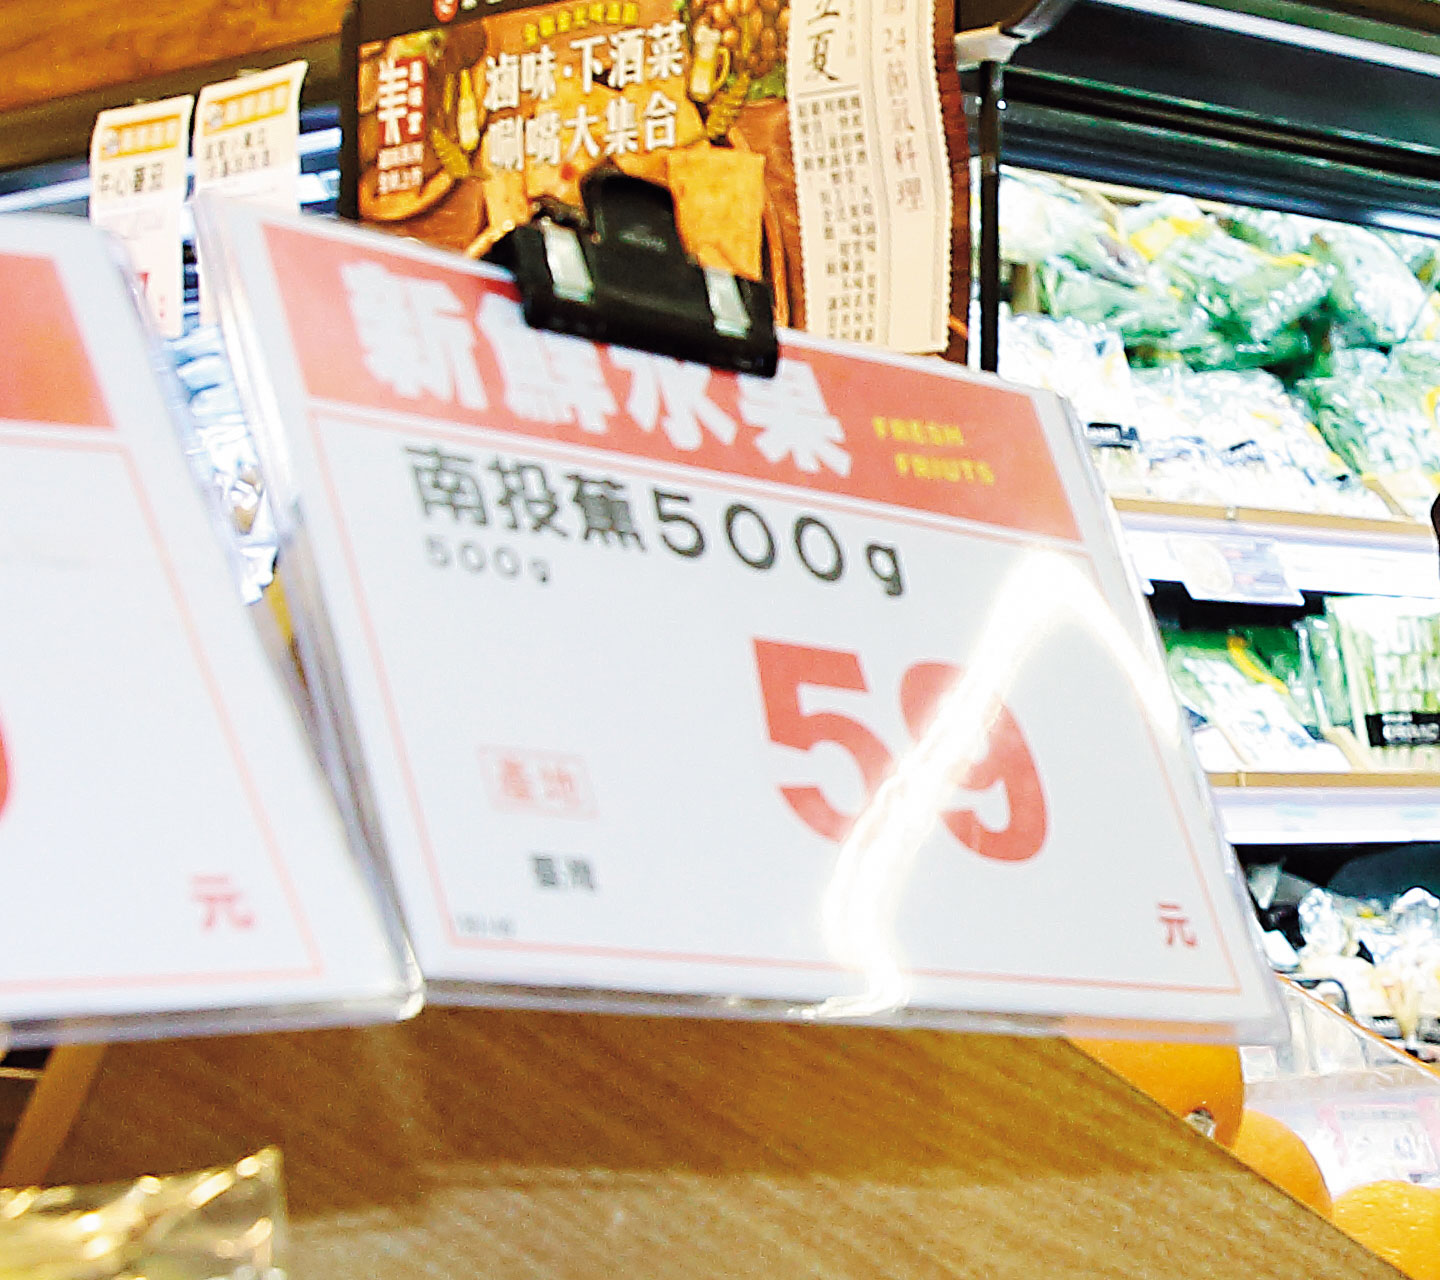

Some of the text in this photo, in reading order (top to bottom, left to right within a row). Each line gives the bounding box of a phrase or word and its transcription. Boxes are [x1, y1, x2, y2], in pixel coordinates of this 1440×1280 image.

[752, 636, 1049, 865] 59
[190, 874, 255, 930] 元
[1157, 901, 1198, 948] 元
